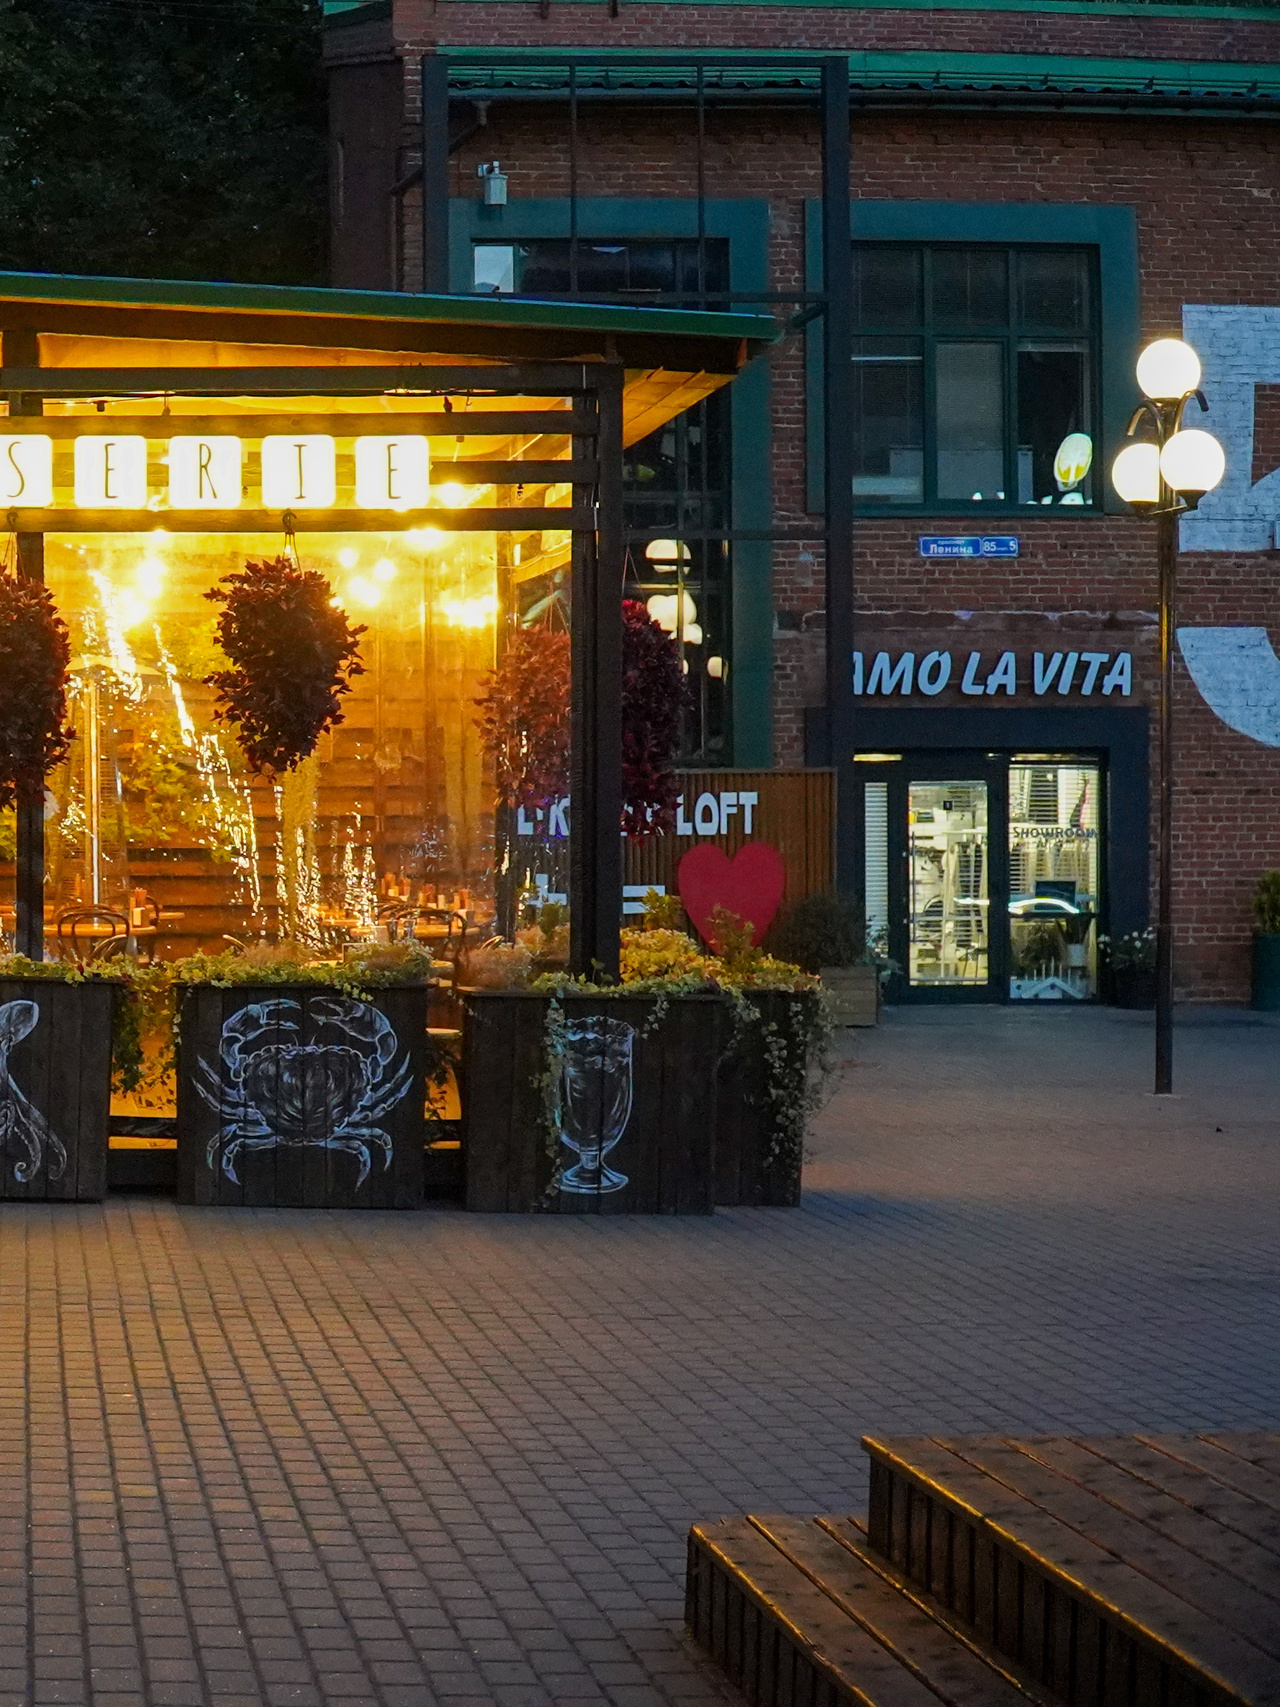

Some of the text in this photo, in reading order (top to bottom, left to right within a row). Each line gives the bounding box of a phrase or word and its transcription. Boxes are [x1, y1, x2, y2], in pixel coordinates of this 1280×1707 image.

[929, 544, 974, 554] Ленина
[984, 541, 997, 551] 85
[961, 651, 1016, 696] LA
[1033, 651, 1132, 696] VITA
[676, 791, 758, 836] LOFT
[1012, 826, 1097, 838] SHOWROOM
